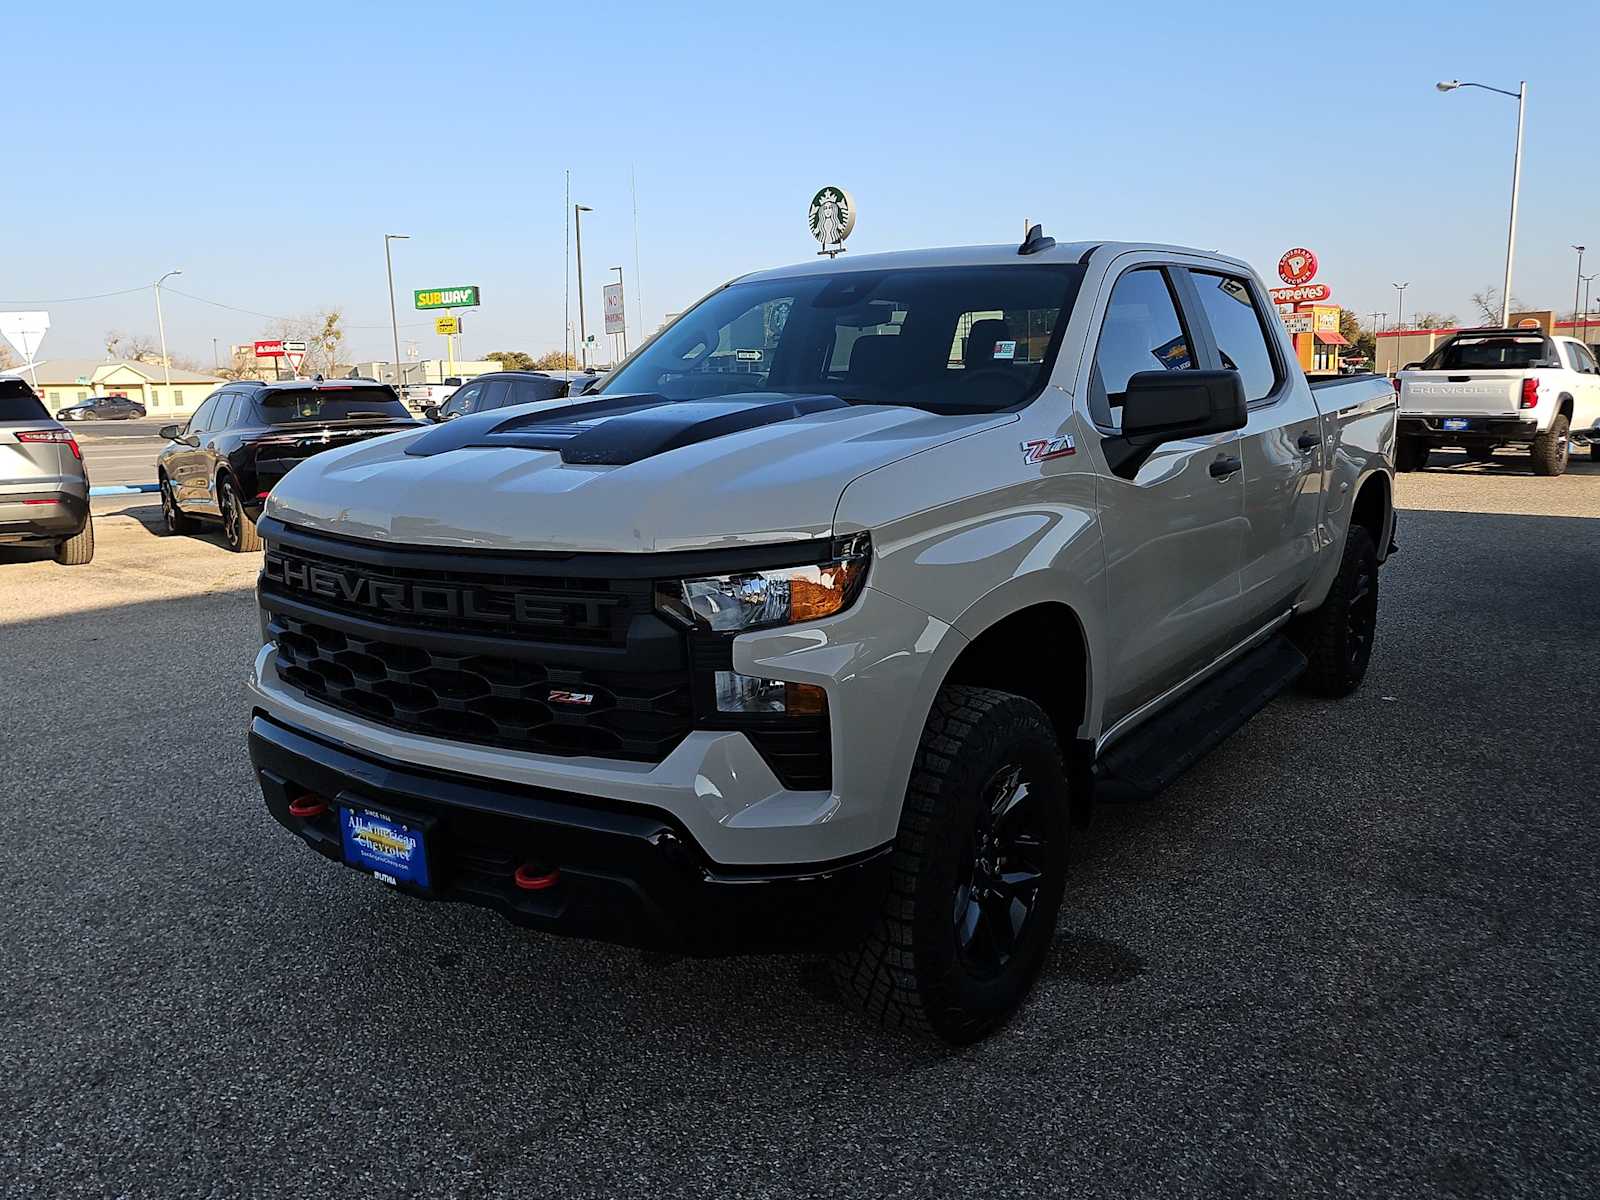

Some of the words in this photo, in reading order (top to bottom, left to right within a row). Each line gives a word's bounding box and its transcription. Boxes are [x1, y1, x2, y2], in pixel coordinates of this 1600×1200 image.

[1280, 249, 1313, 266] LOUISIANA
[1288, 256, 1305, 276] P
[1281, 271, 1312, 285] KITCHEN
[417, 291, 468, 306] SUBWAY
[608, 295, 618, 306] NO
[1409, 385, 1506, 394] CHEVROLET
[1020, 434, 1076, 465] Z71
[265, 555, 620, 627] CHEVROLET
[348, 815, 363, 830] All
[366, 821, 417, 848] American
[357, 834, 410, 861] Chevrolet
